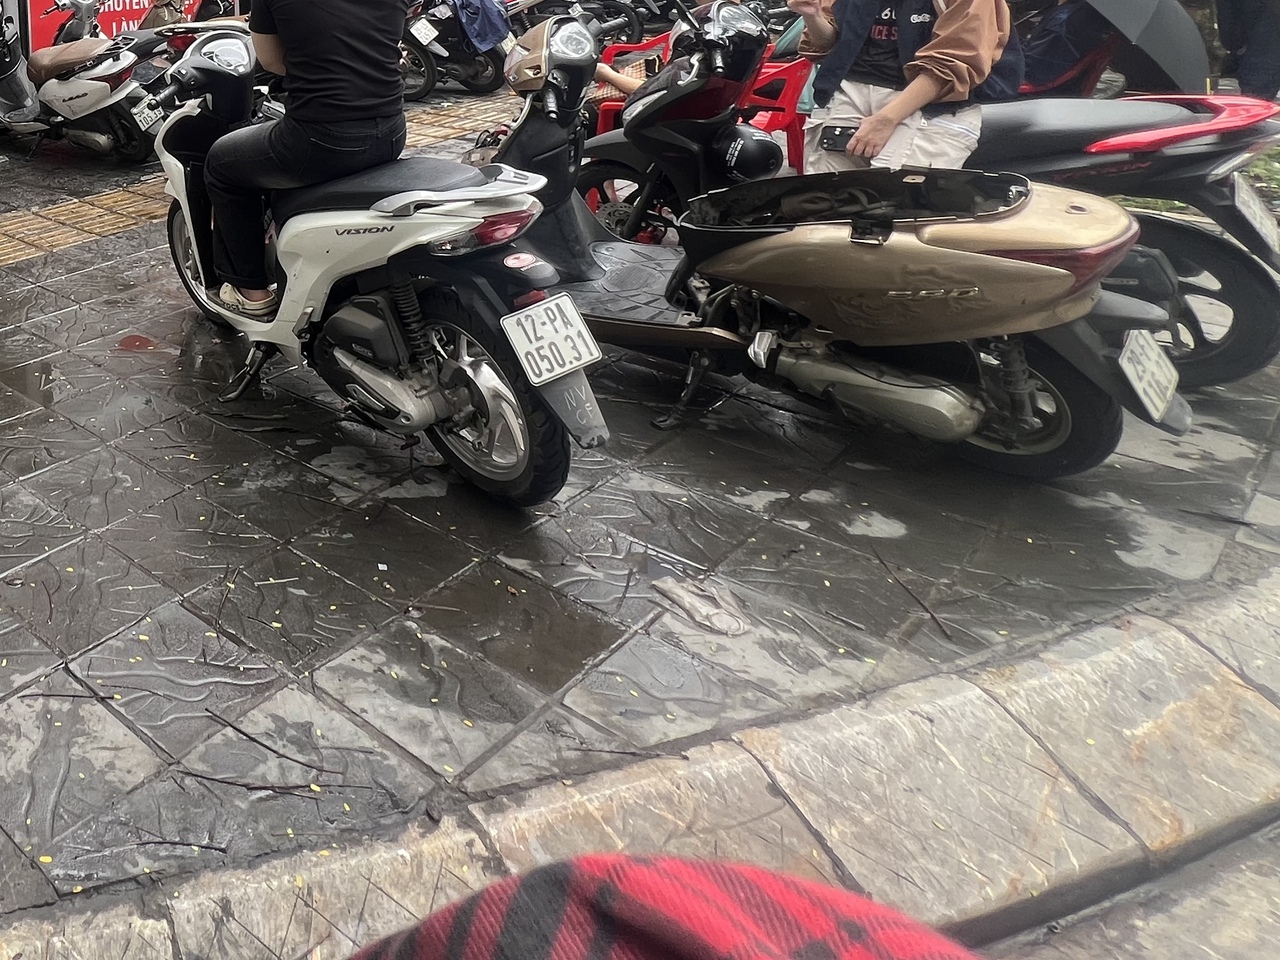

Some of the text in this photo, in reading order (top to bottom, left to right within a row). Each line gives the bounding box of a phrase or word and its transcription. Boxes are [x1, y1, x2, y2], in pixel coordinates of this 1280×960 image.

[335, 225, 395, 237] VISION
[515, 302, 574, 345] 12-PA
[524, 329, 594, 379] 050.31
